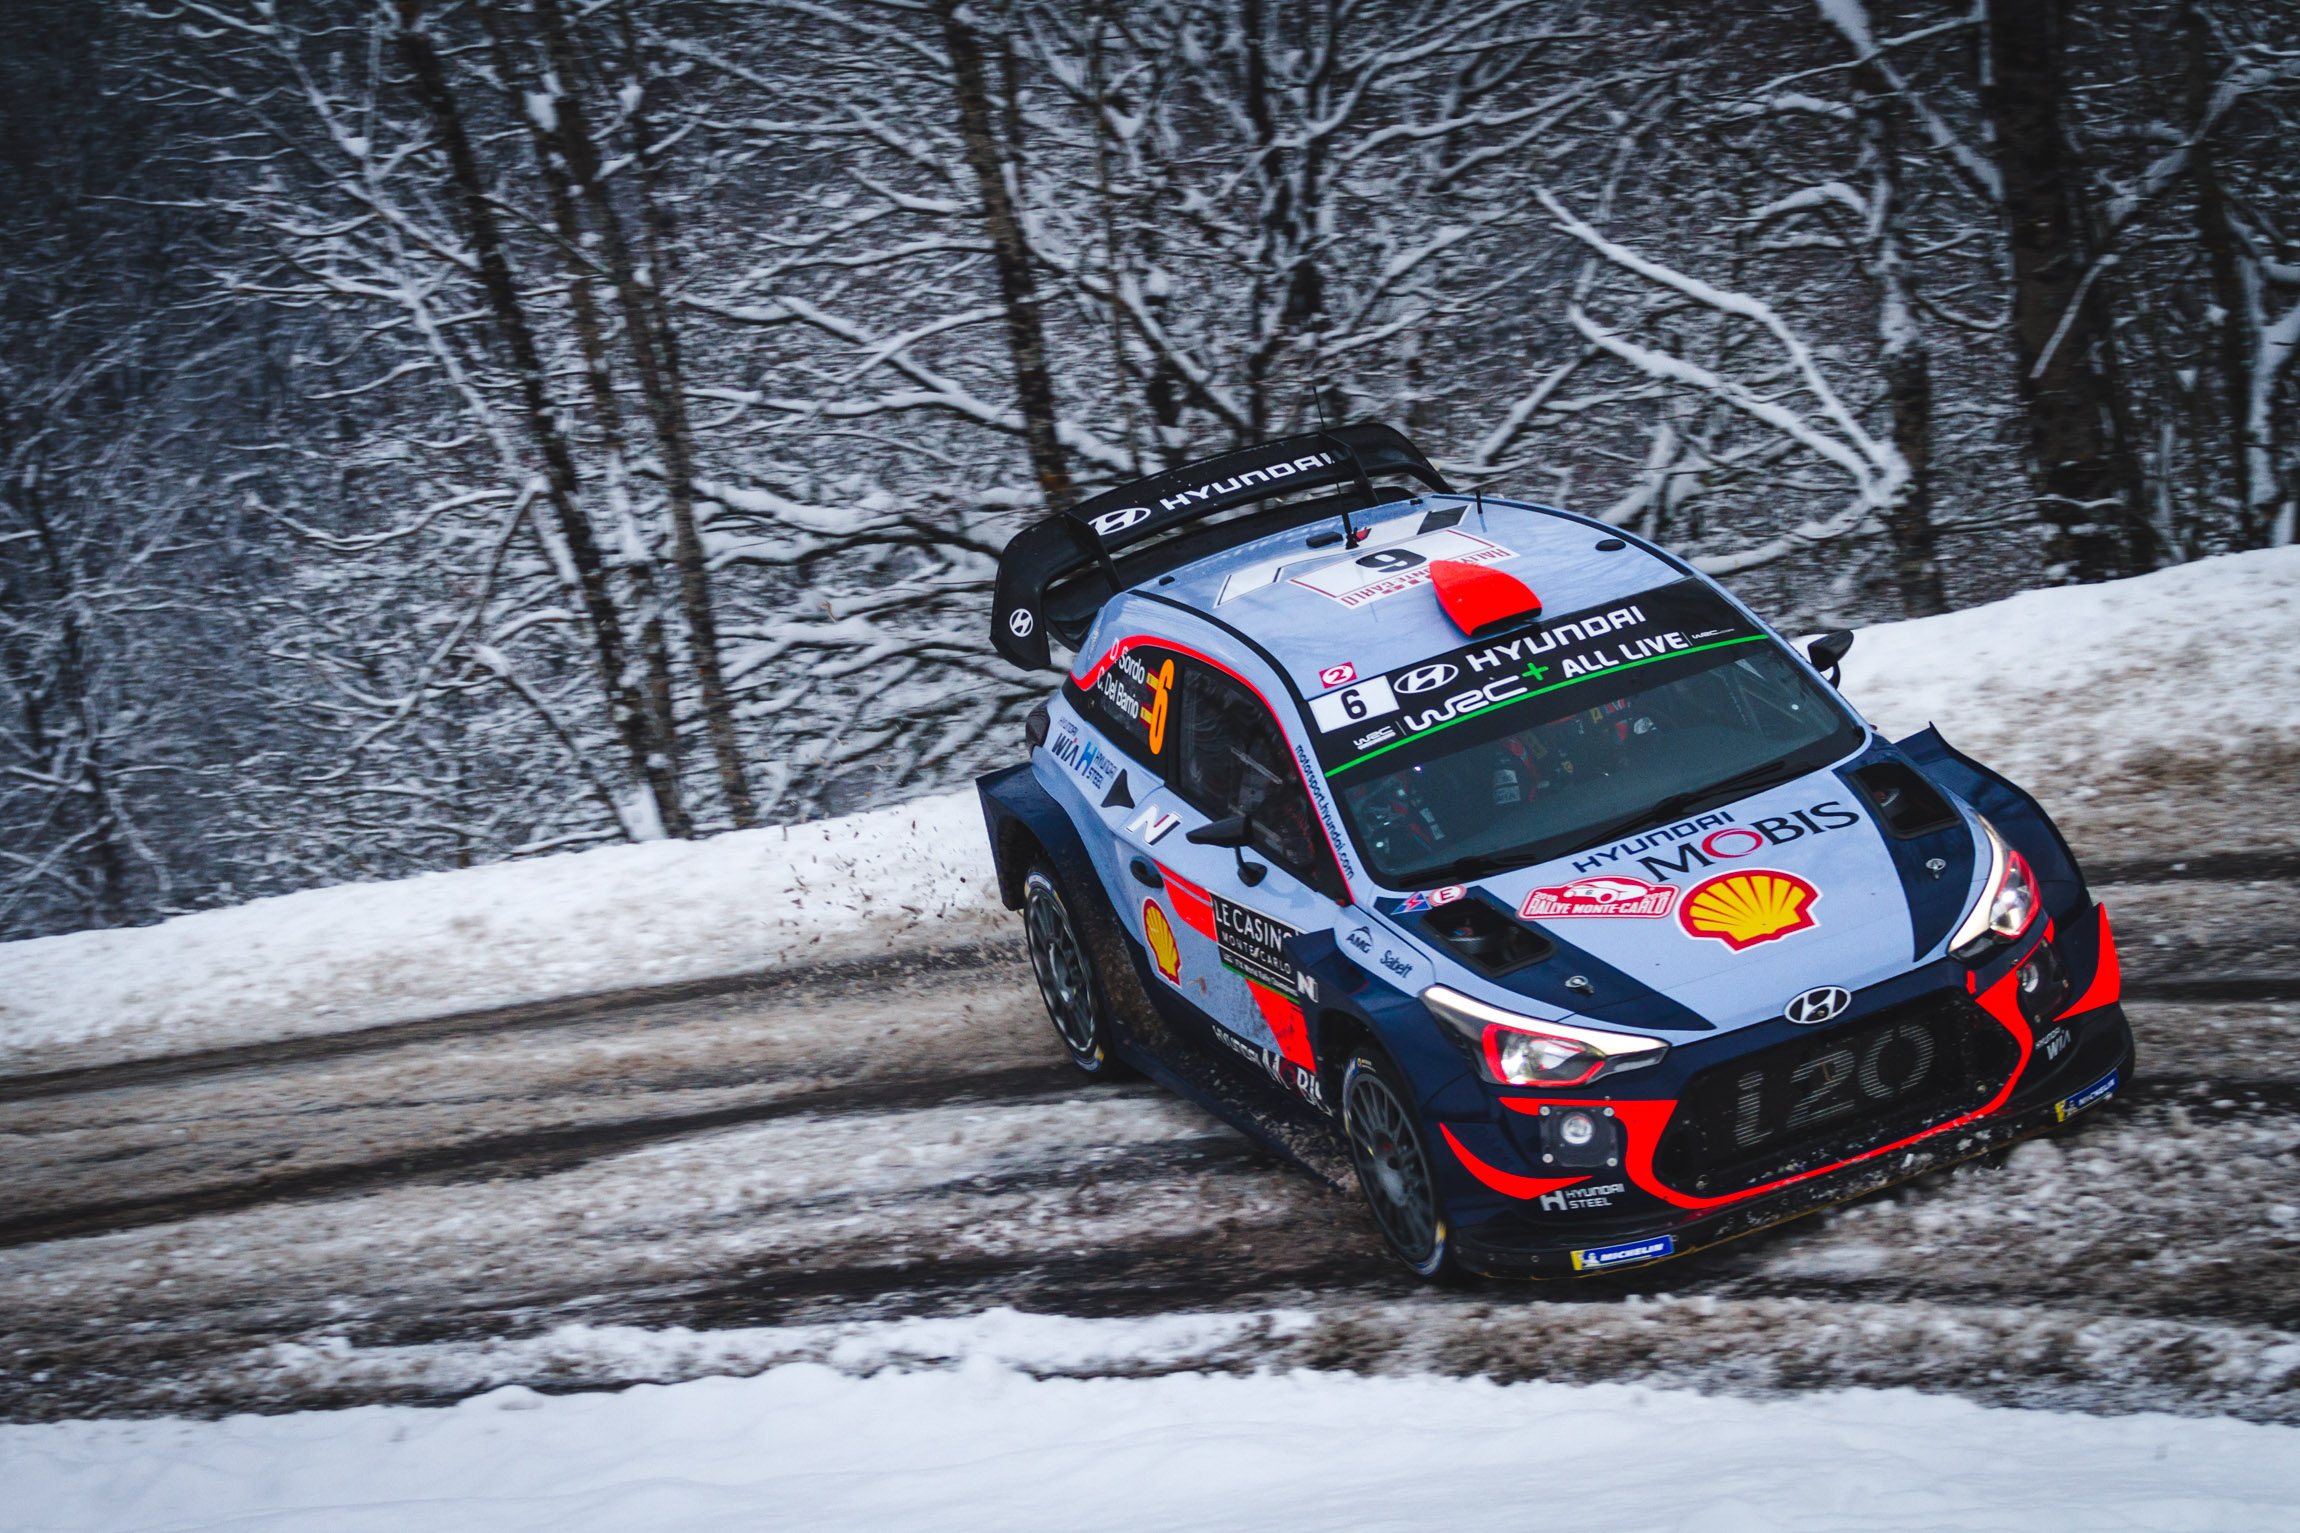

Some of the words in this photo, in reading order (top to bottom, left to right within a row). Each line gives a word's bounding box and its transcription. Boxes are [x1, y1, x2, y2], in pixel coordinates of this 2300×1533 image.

[1160, 452, 1336, 511] HYUNDAI
[1460, 548, 1512, 565] RALLY
[1465, 605, 1647, 672] HYUNDAI
[1561, 650, 1620, 679] ALL
[1617, 631, 1690, 661] LIVE
[1109, 636, 1120, 664] D.
[1118, 645, 1146, 685] Sordo
[1327, 668, 1347, 684] 2
[1096, 665, 1106, 692] C.
[1103, 672, 1119, 702] Del
[1115, 687, 1140, 720] Barrio
[1149, 658, 1175, 755] 6
[1340, 688, 1368, 720] 6
[1352, 725, 1395, 747] WRC
[1294, 744, 1356, 880] motorsport.hyundai.com
[1572, 811, 1735, 873] HYUNDAI
[1637, 801, 1860, 883] MOBIS
[1439, 886, 1456, 902] E
[1525, 899, 1571, 915] RALLYE
[1572, 897, 1667, 915] MONTE-CARLO
[1213, 899, 1232, 928] LE
[1221, 929, 1256, 956] MONTE
[1259, 950, 1292, 975] CARLO
[1296, 970, 1319, 1004] N
[1565, 1183, 1625, 1199] HYUNDAI
[1568, 1197, 1613, 1209] STEEL
[1600, 1243, 1665, 1262] MICHELIN
